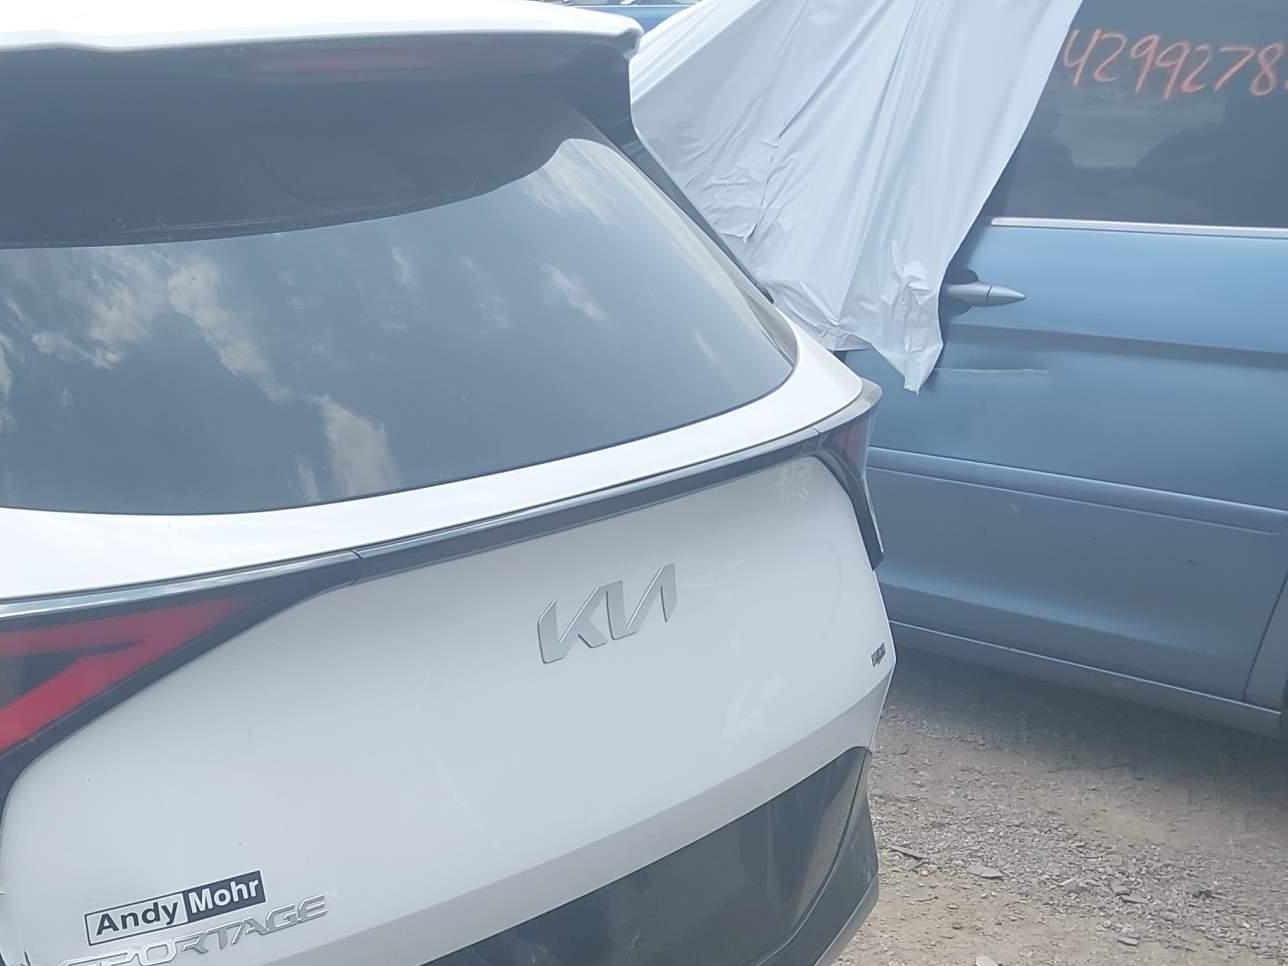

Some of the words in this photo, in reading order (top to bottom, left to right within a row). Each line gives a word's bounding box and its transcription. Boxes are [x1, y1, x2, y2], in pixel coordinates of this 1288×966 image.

[1063, 28, 1288, 99] 4299278
[96, 900, 179, 937] Andy
[188, 877, 260, 914] Mohr
